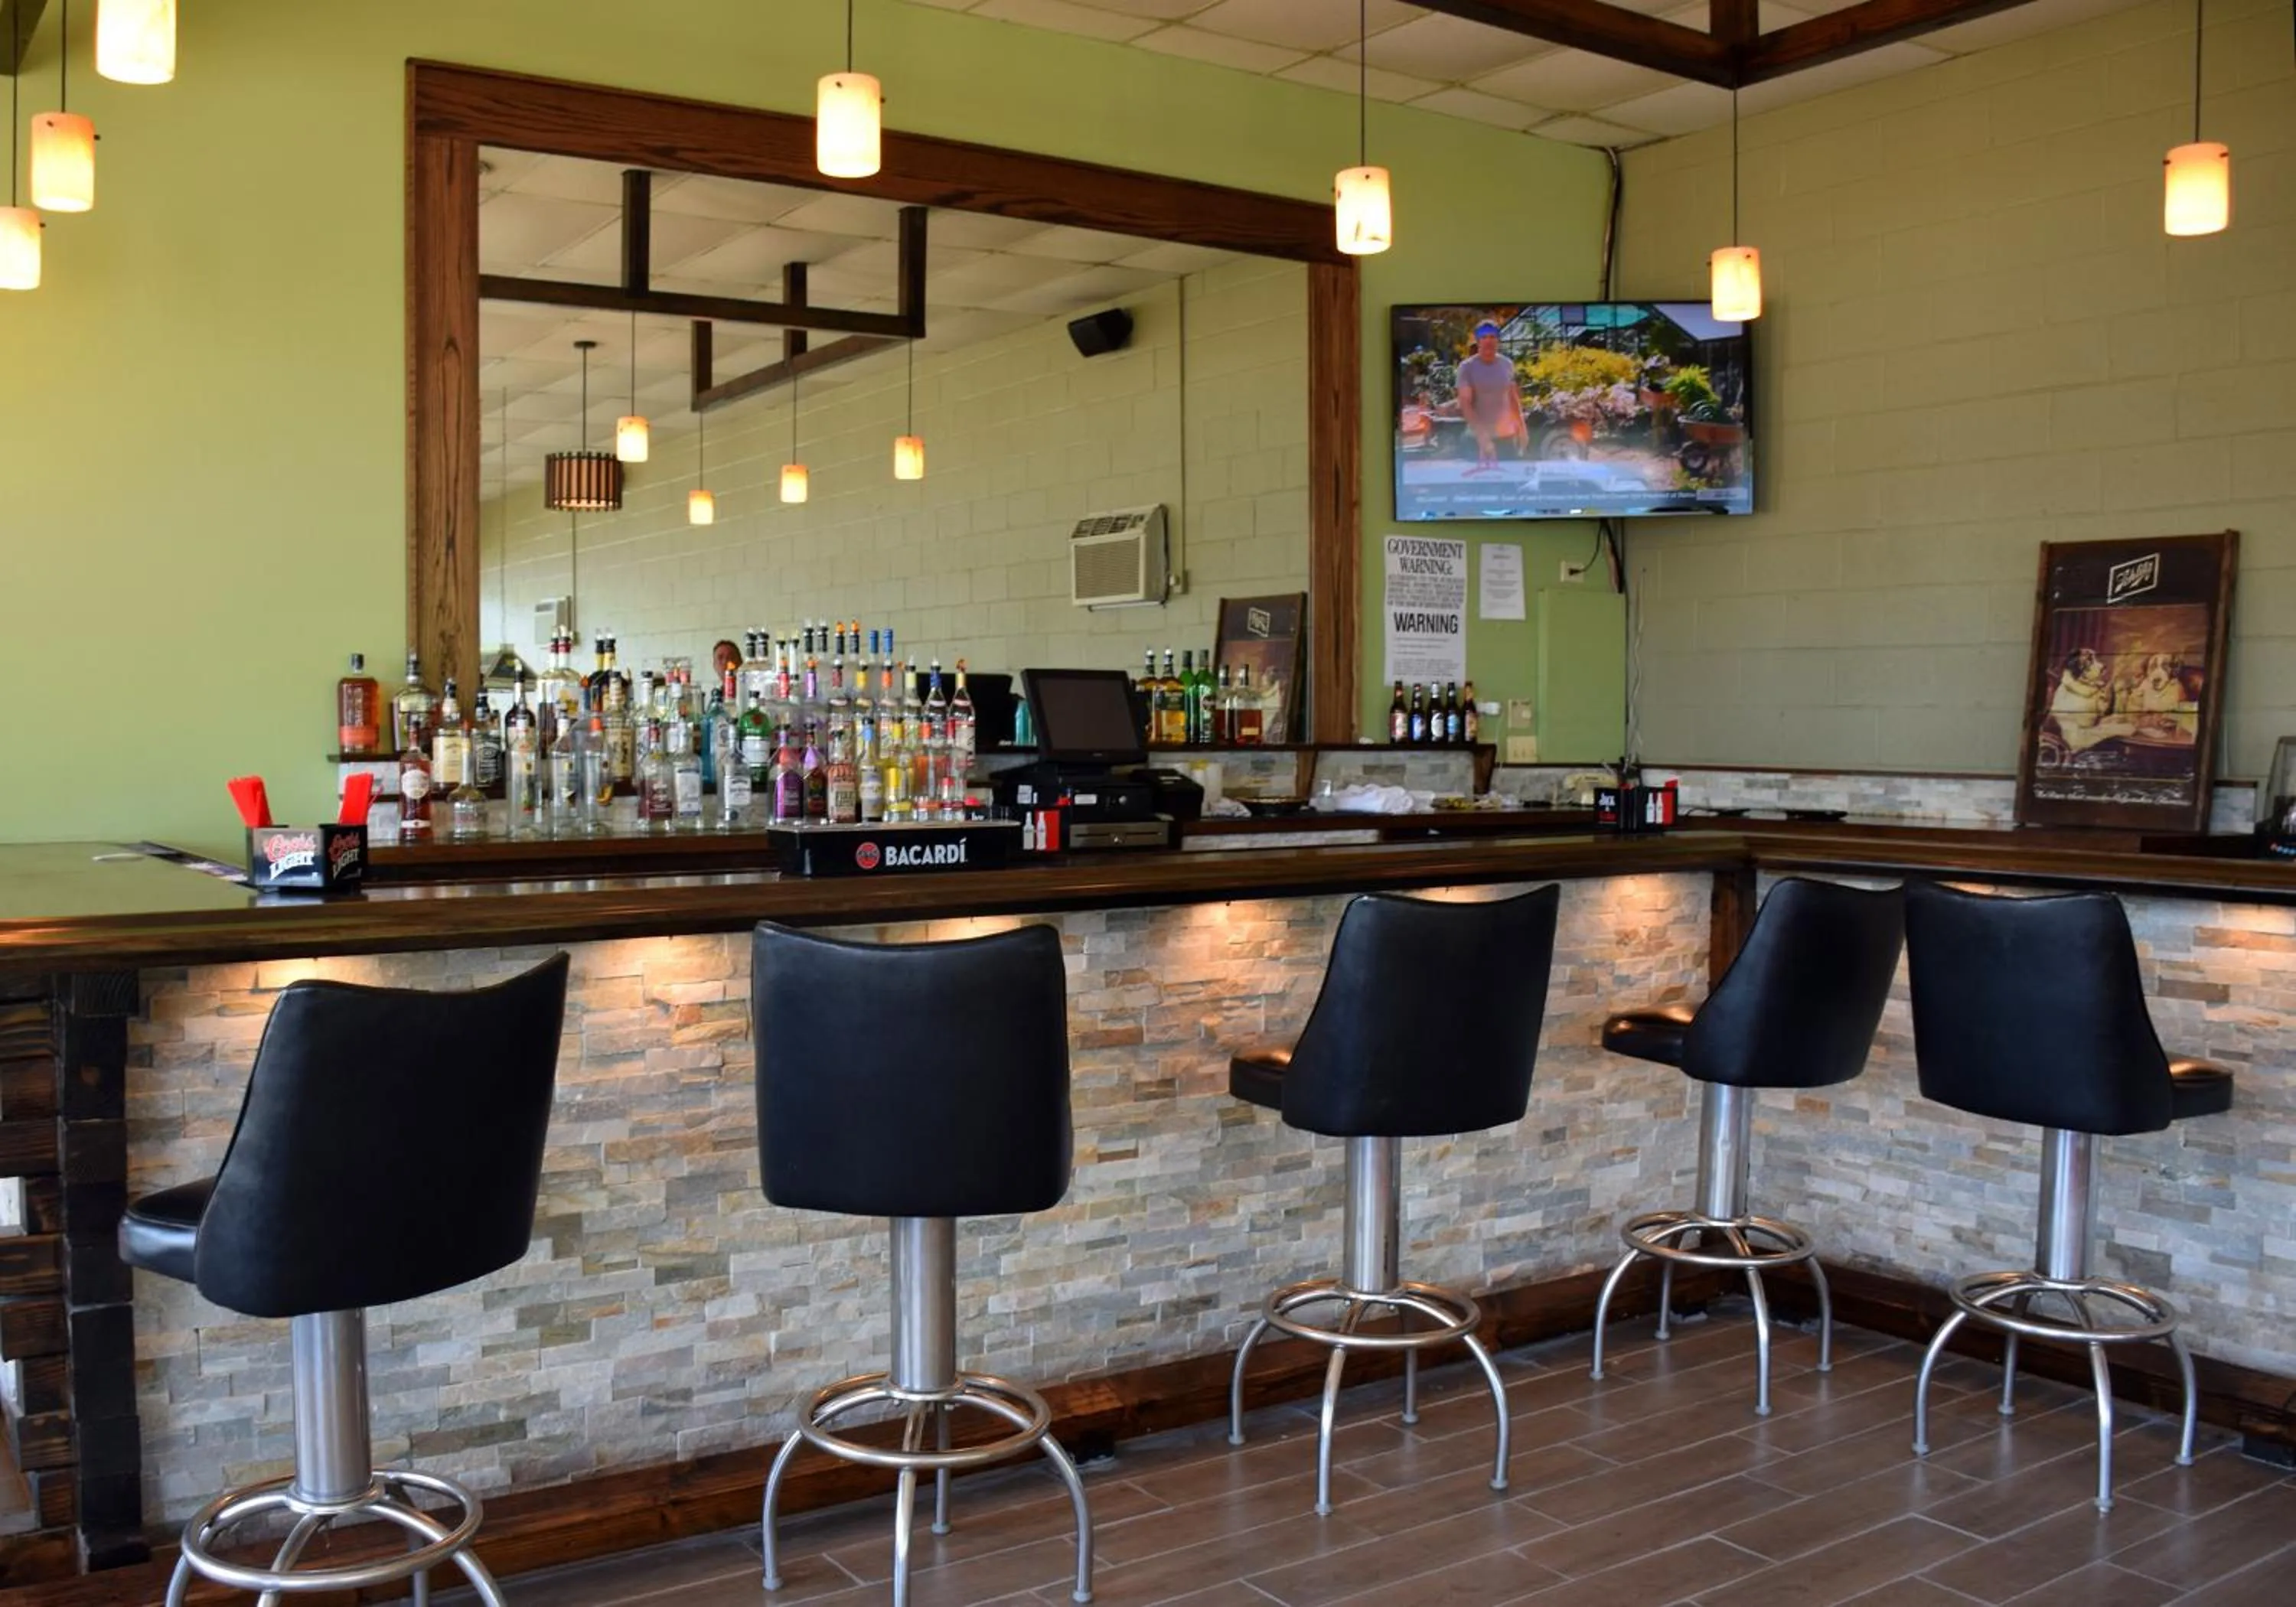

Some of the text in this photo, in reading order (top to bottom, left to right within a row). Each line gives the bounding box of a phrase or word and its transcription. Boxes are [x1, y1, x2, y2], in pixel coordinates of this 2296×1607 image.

[1388, 539, 1463, 559] GOVERNMENT
[1394, 612, 1458, 634] WARNING
[885, 836, 967, 865] BACARDÍ
[269, 851, 314, 880] LIGHT
